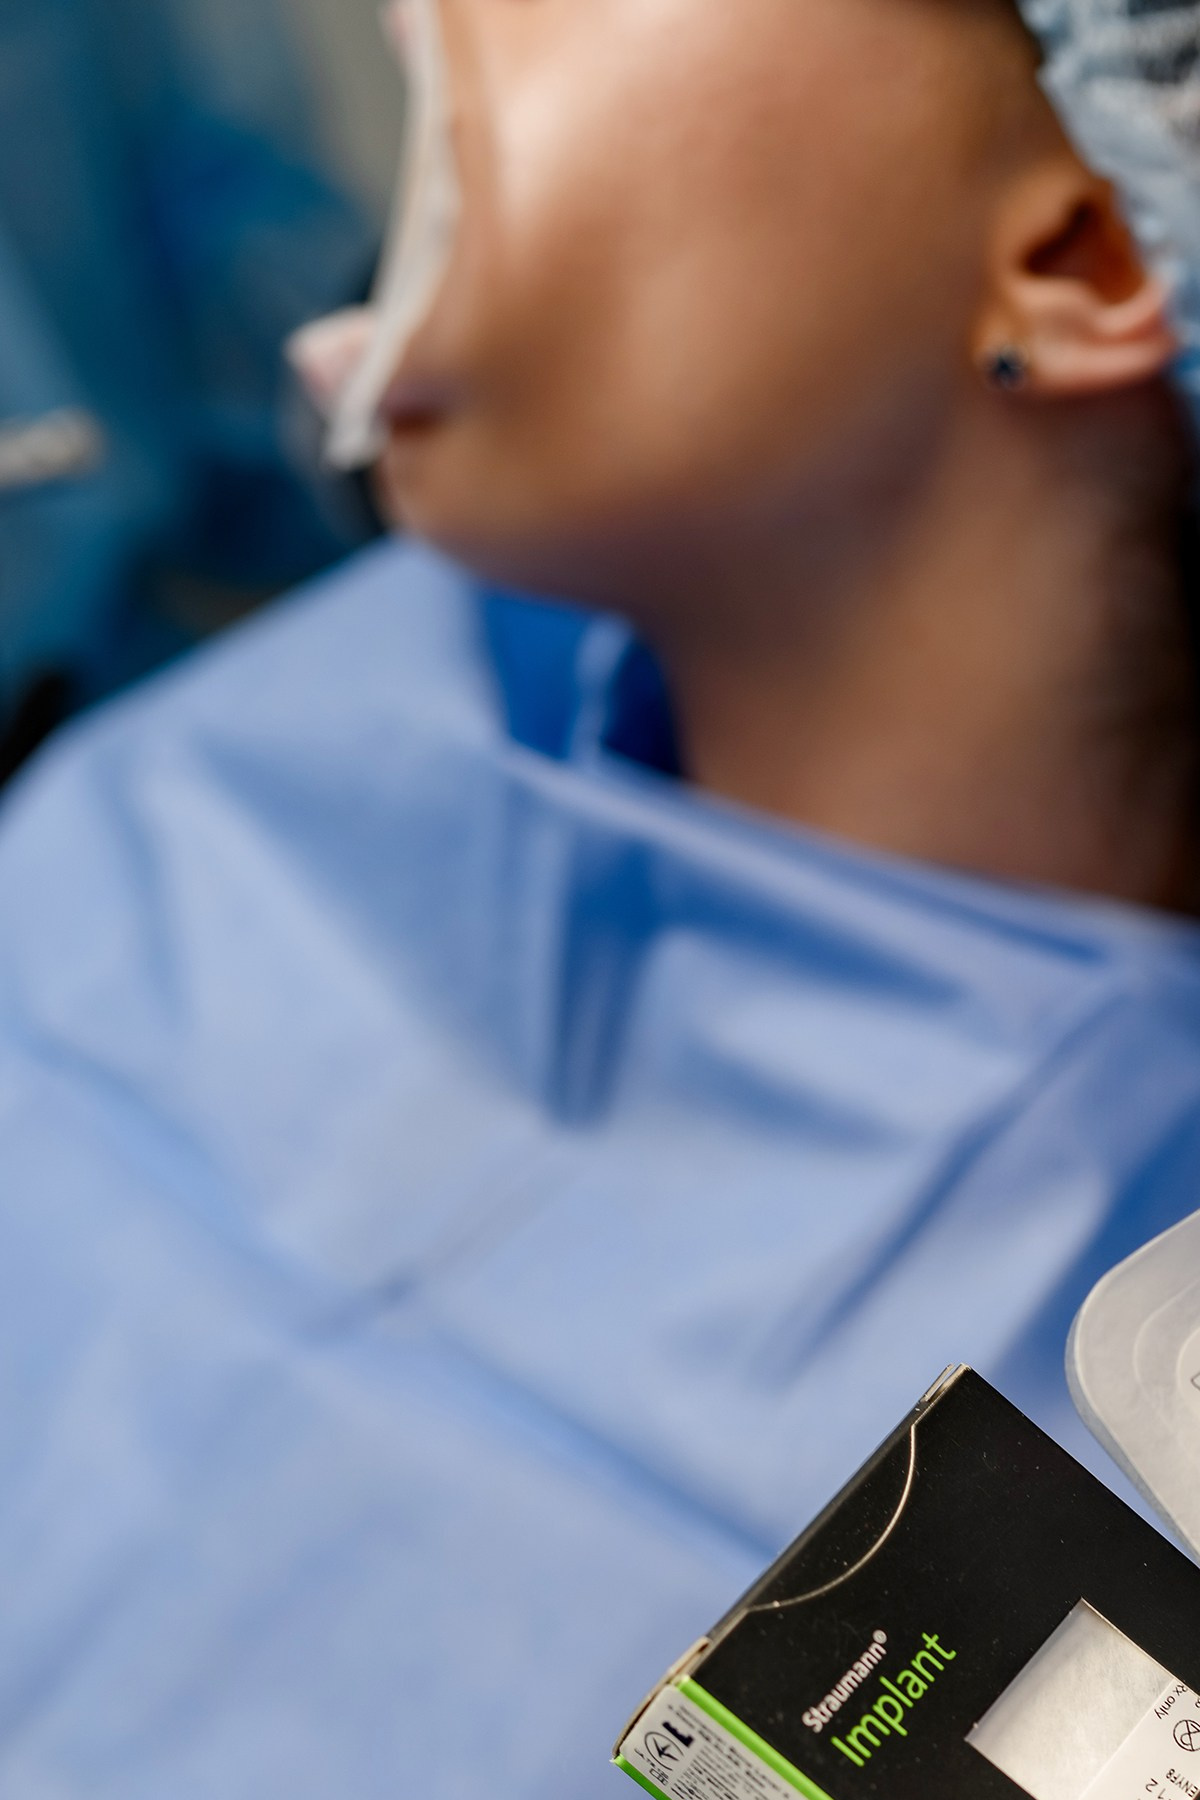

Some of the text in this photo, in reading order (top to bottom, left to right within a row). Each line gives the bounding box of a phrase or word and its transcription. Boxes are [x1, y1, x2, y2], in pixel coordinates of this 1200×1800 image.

[801, 1629, 888, 1734] Straumann®
[830, 1631, 957, 1767] Implant
[1153, 1696, 1176, 1720] only
